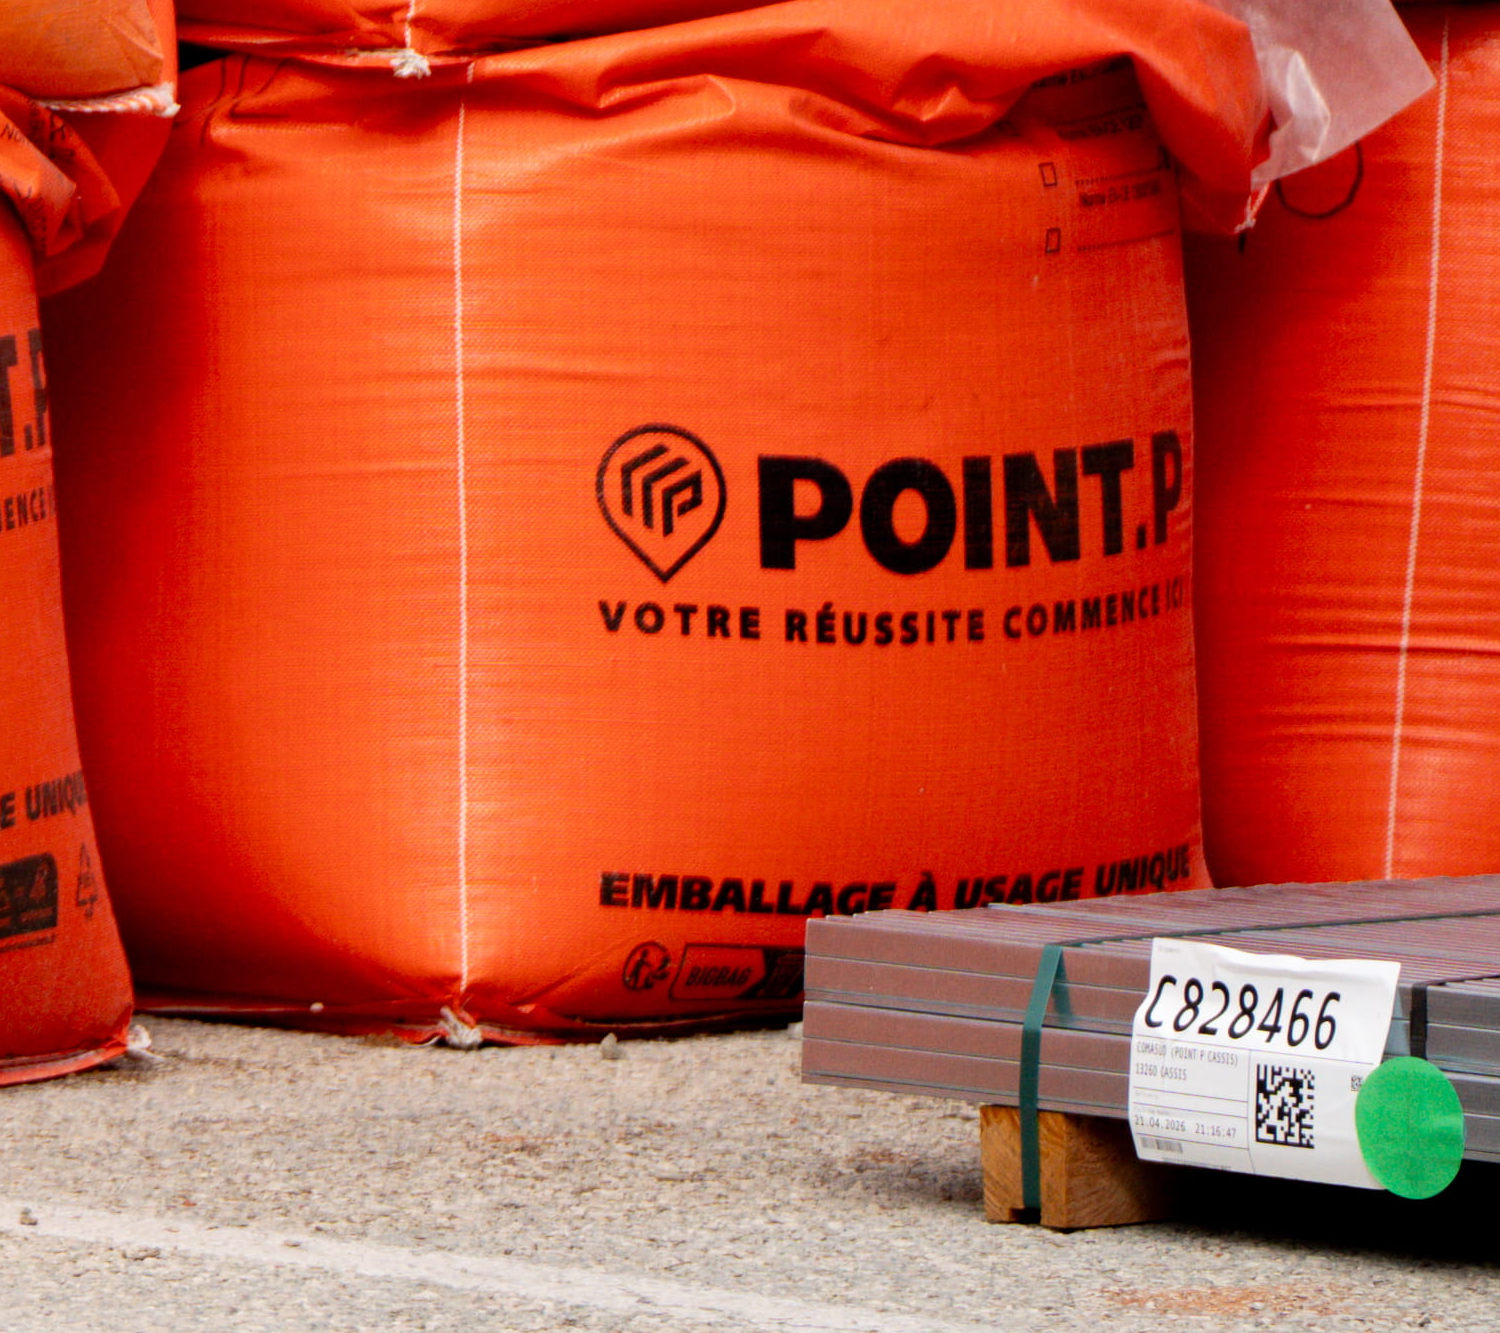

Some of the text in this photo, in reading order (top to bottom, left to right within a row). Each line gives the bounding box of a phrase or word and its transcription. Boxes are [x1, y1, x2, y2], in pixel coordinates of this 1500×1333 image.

[758, 430, 1183, 574] POINT.P
[598, 599, 762, 641] VOTRE
[784, 600, 986, 645] RÉUSSITE
[1003, 583, 1161, 641] COMMENCE
[600, 843, 1191, 916] EMBALLAGE À USAGE UNIQUE
[684, 964, 753, 987] BIGBAG
[1144, 974, 1341, 1051] C828466
[1160, 1064, 1188, 1082] CASSIS
[1170, 1045, 1198, 1061] (POINT
[1207, 1050, 1239, 1068] CASSIS)
[1133, 1113, 1237, 1139] 21.04.2026 21:16:47
